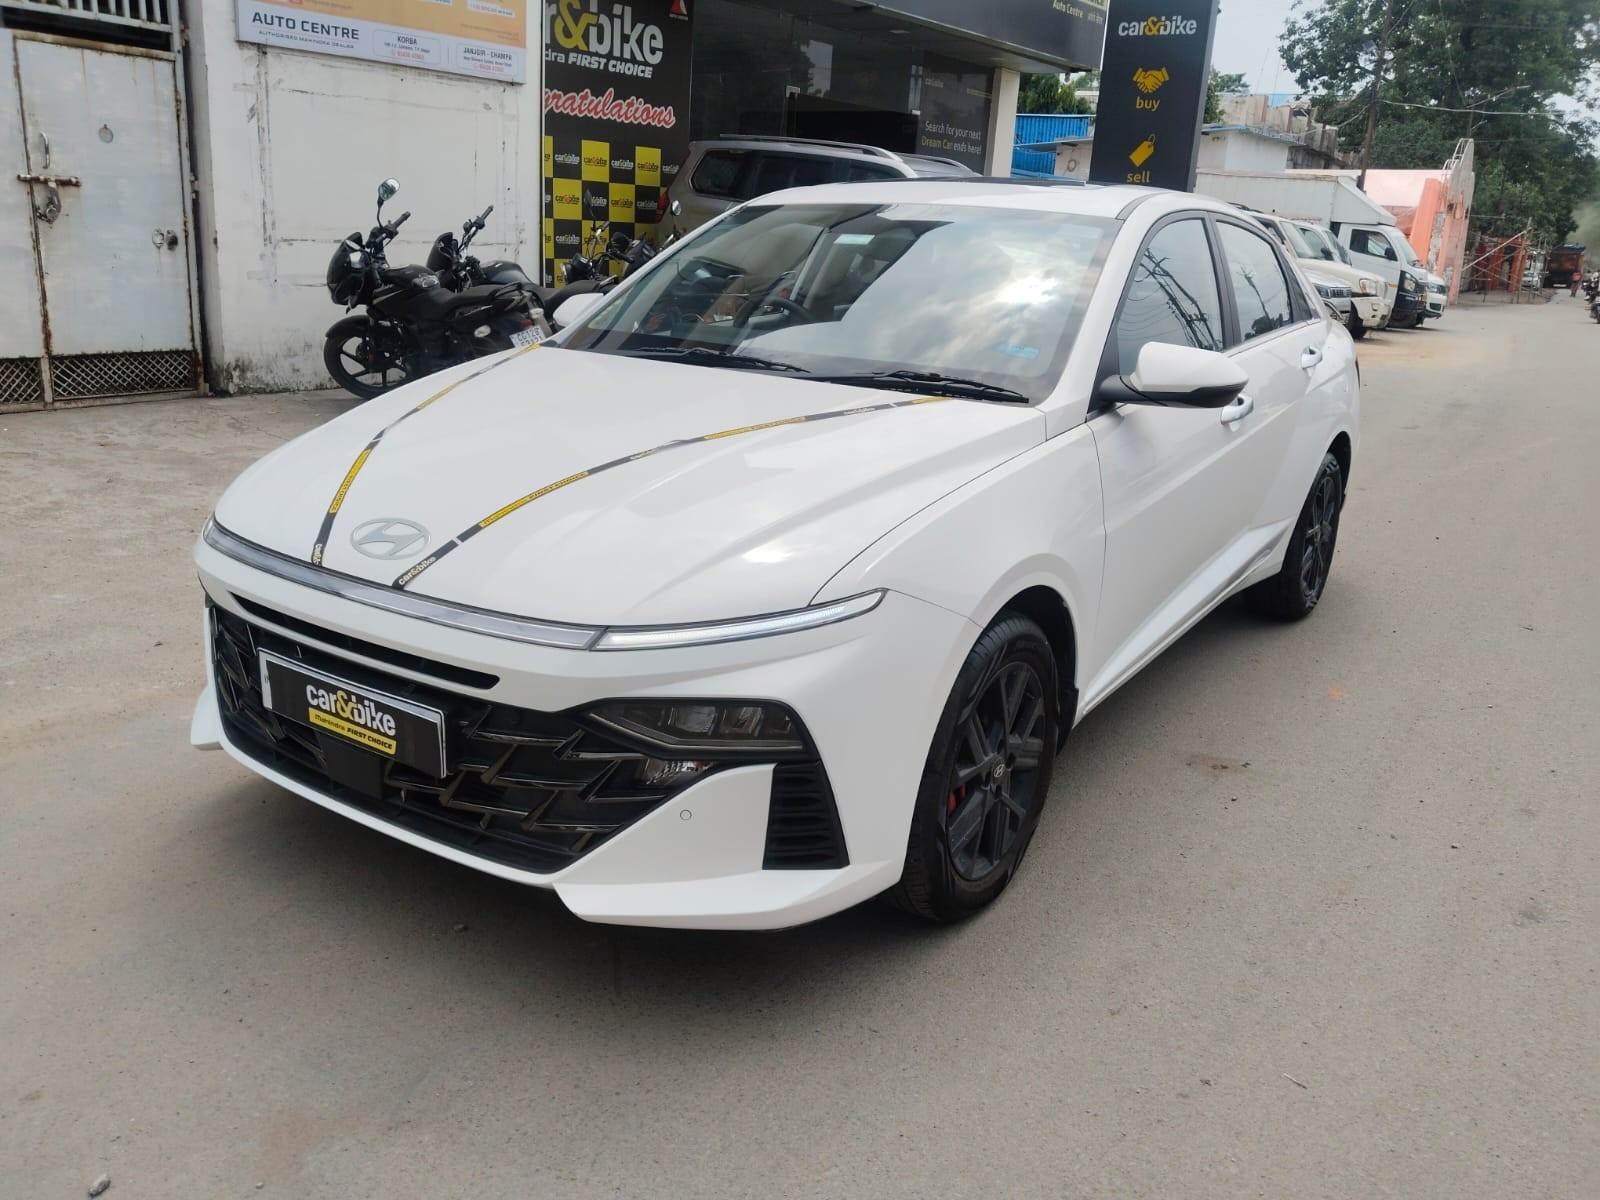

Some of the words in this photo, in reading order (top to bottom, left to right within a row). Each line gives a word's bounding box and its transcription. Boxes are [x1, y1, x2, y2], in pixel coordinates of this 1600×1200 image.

[252, 12, 296, 30] AUTO
[300, 20, 360, 40] CENTRE
[1118, 15, 1197, 36] car&bike
[397, 35, 418, 45] KORBA
[568, 52, 608, 70] FIRST
[608, 60, 653, 78] CHOICE
[1135, 96, 1160, 112] buy
[925, 121, 944, 133] Search
[954, 128, 968, 139] your
[921, 136, 941, 149] Dream
[942, 139, 953, 150] Car
[1126, 171, 1150, 183] sell
[306, 684, 396, 736] car&bike
[314, 713, 346, 731] Mahindra
[346, 727, 368, 740] FIRST
[368, 734, 394, 750] CHOICE
